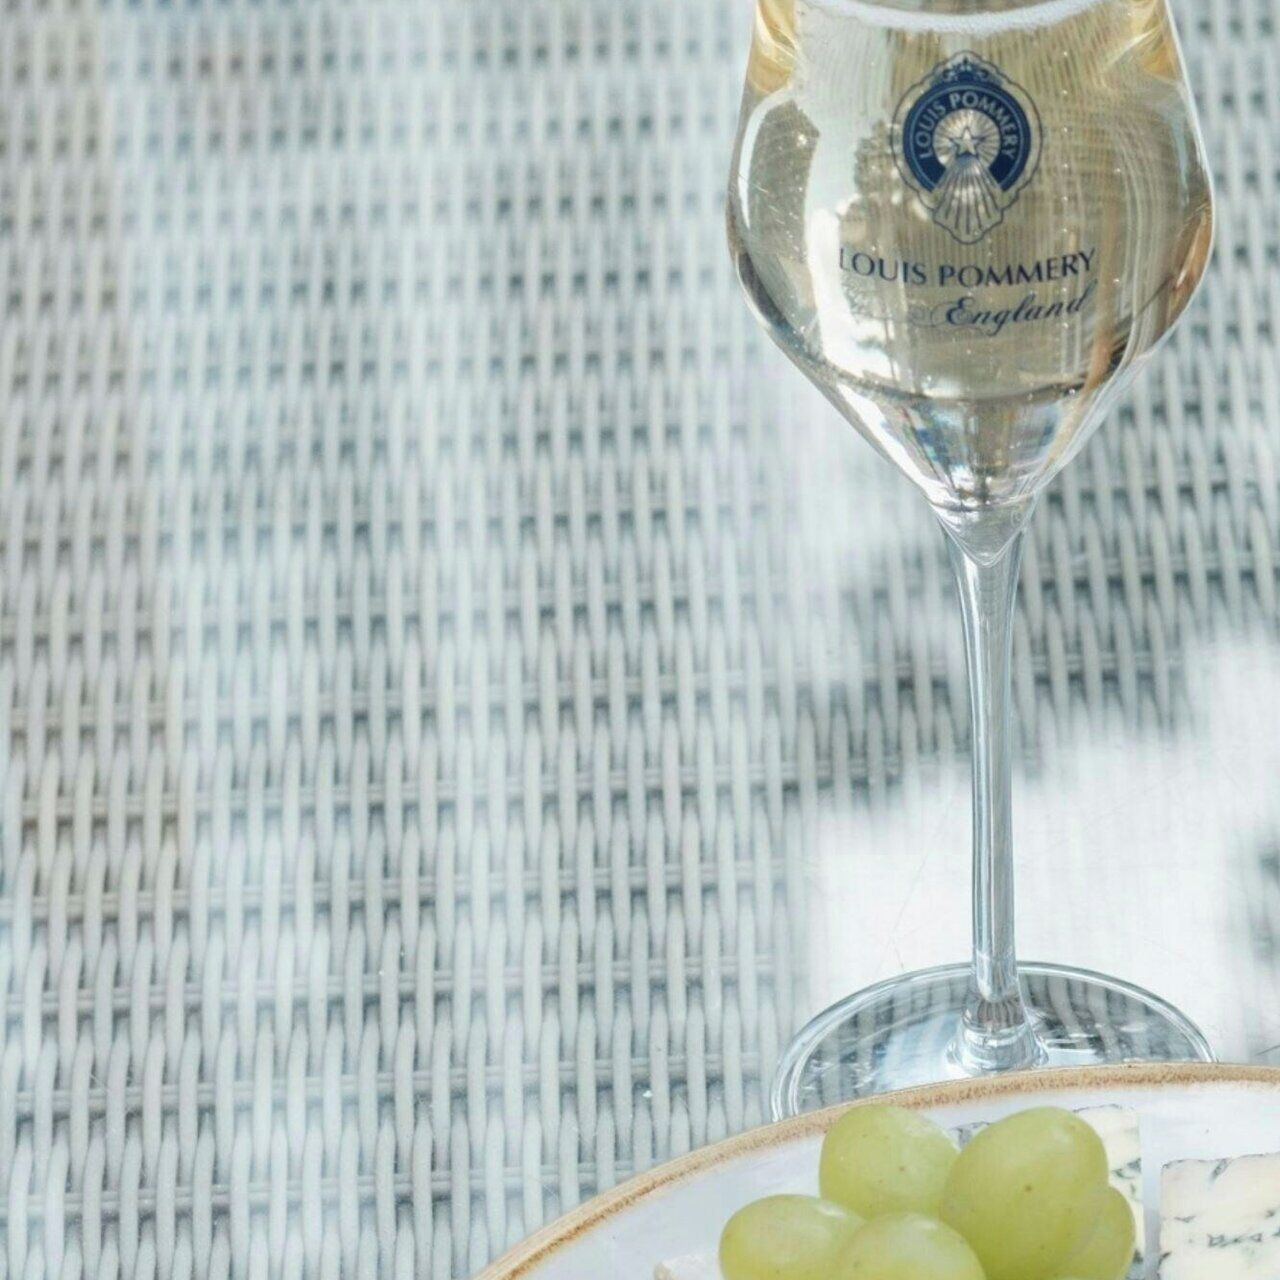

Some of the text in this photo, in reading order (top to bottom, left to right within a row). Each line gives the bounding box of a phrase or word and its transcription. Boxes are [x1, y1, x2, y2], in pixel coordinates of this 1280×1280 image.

[915, 90, 1018, 160] LOUIS POMMERY
[839, 247, 1096, 288] LOUIS POMMERY
[943, 278, 1098, 337] England
